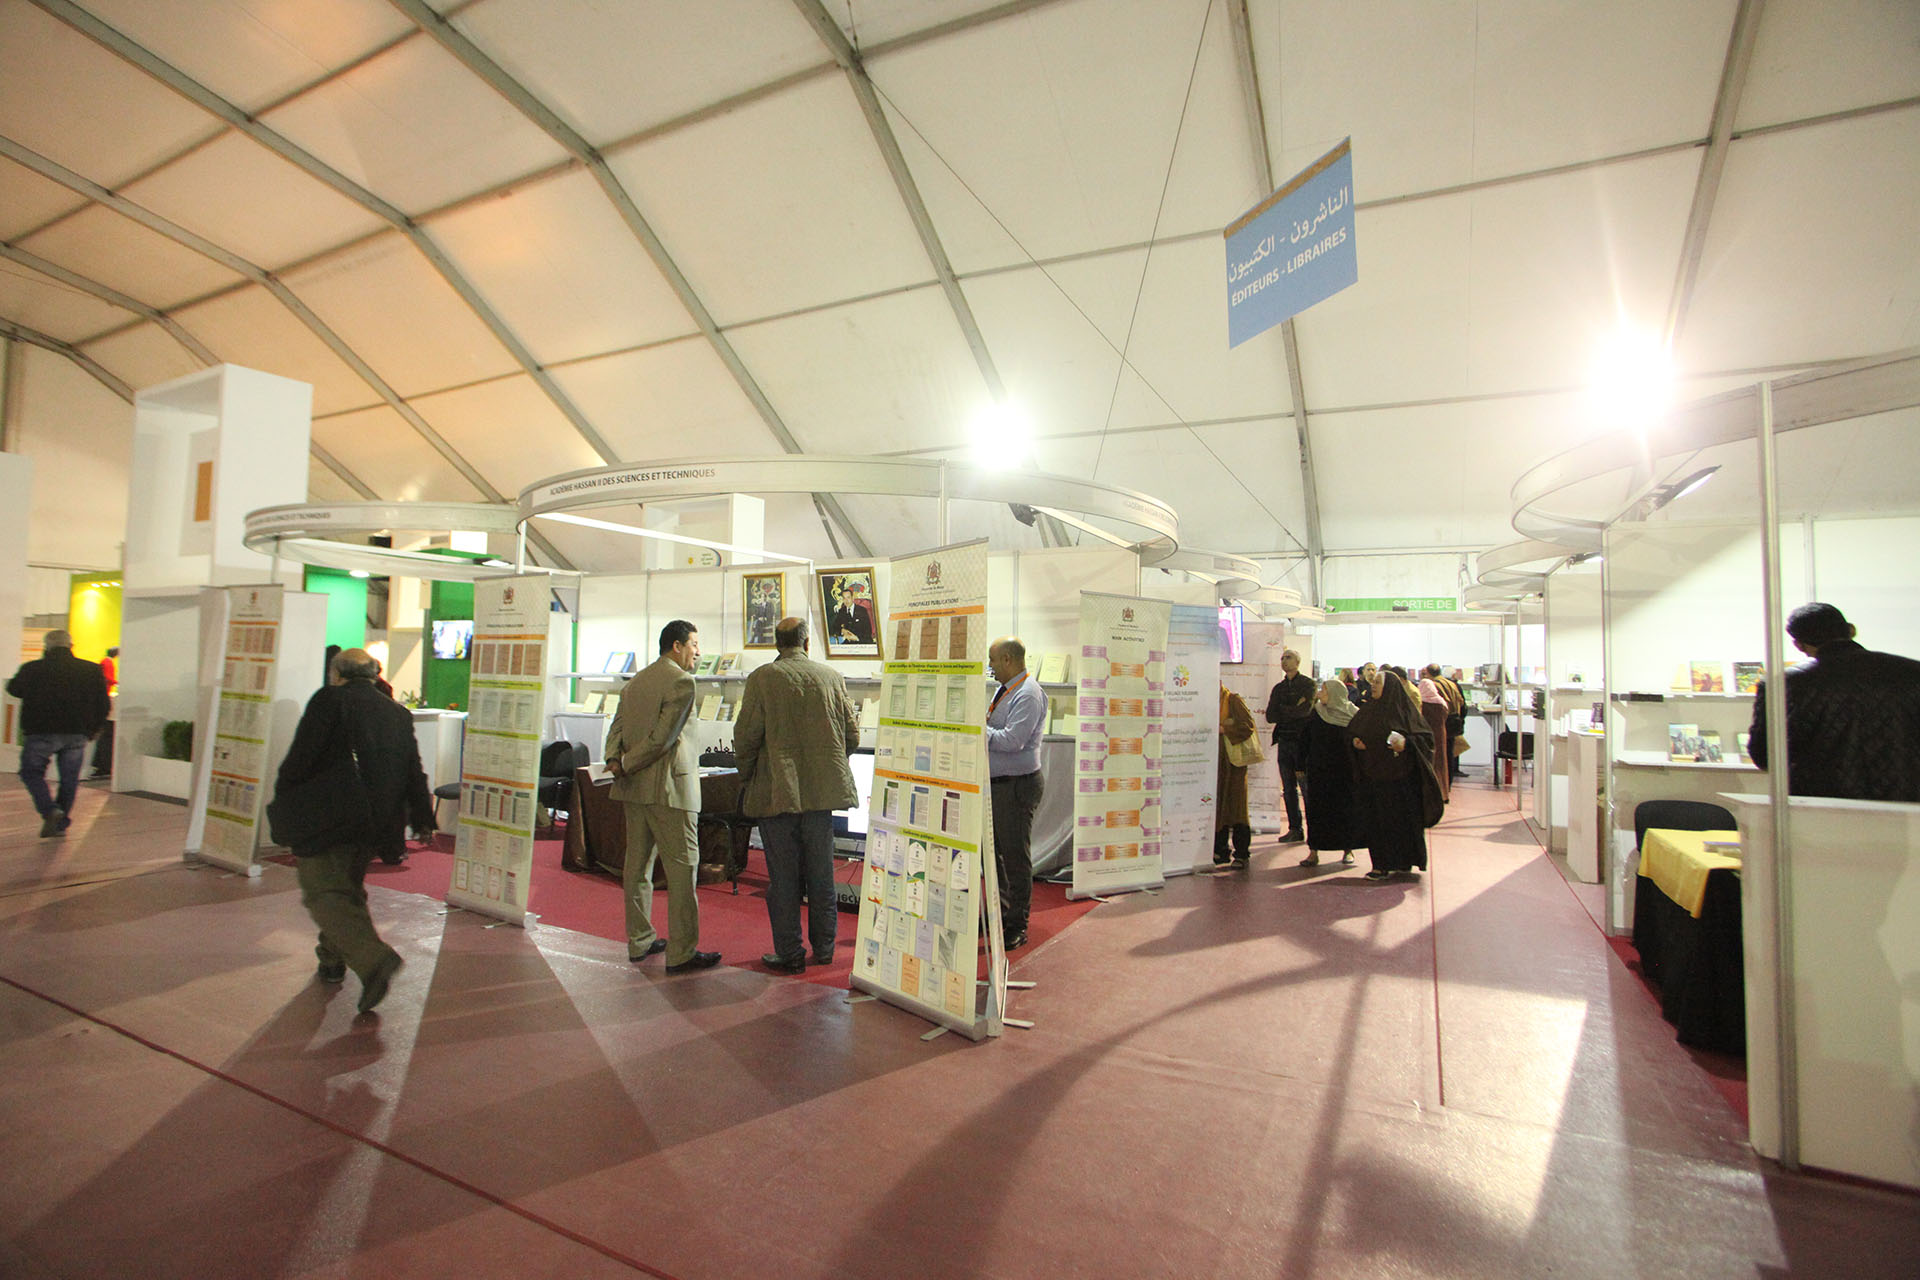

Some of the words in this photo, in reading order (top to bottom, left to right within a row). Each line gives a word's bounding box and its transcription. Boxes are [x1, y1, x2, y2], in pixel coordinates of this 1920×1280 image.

[1290, 185, 1349, 244] الناشرون
[1228, 235, 1275, 283] الكتبيون
[1287, 226, 1347, 274] LIBRAIRES
[573, 479, 597, 490] HASSAN
[602, 476, 616, 486] DES
[616, 472, 650, 484] SCIENCES
[651, 471, 661, 481] ET
[662, 468, 716, 480] TECHNIQUES
[1392, 599, 1434, 609] SORTIE
[1437, 599, 1452, 609] DE
